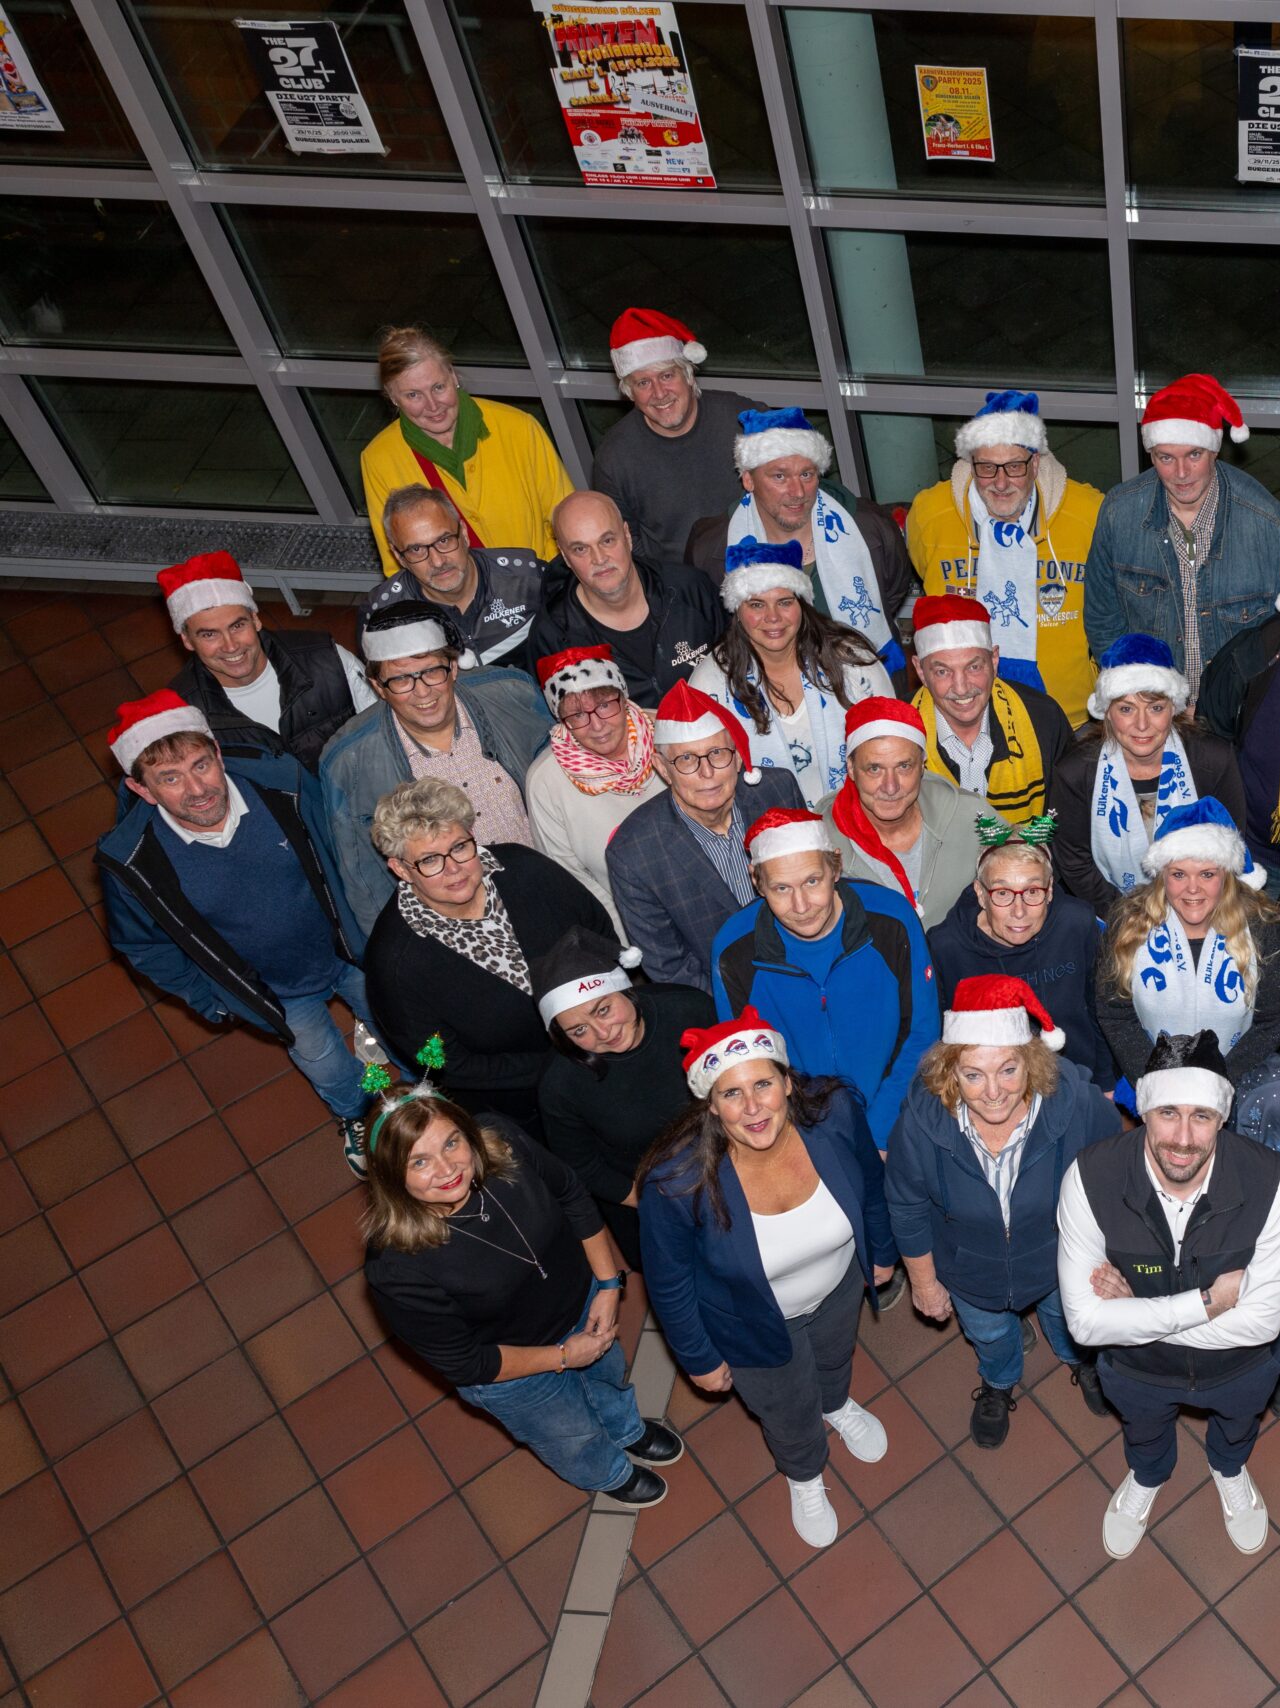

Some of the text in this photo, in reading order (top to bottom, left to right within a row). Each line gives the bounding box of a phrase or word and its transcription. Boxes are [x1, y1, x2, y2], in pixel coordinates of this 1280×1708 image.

[620, 6, 662, 16] DÜLKEN
[261, 36, 286, 46] THE
[553, 18, 660, 52] PRINZEN
[578, 42, 674, 64] Proklamation
[278, 77, 326, 90] CLUB
[938, 76, 982, 86] PARTY 2025
[640, 98, 695, 118] AUSVERKAUFT
[483, 604, 526, 623] DÜLKENER
[509, 616, 519, 625] FC
[671, 643, 708, 667] DÜLKENER
[1096, 766, 1111, 817] Dülkener
[1178, 780, 1191, 799] e.V.
[1132, 1263, 1164, 1275] Tim
